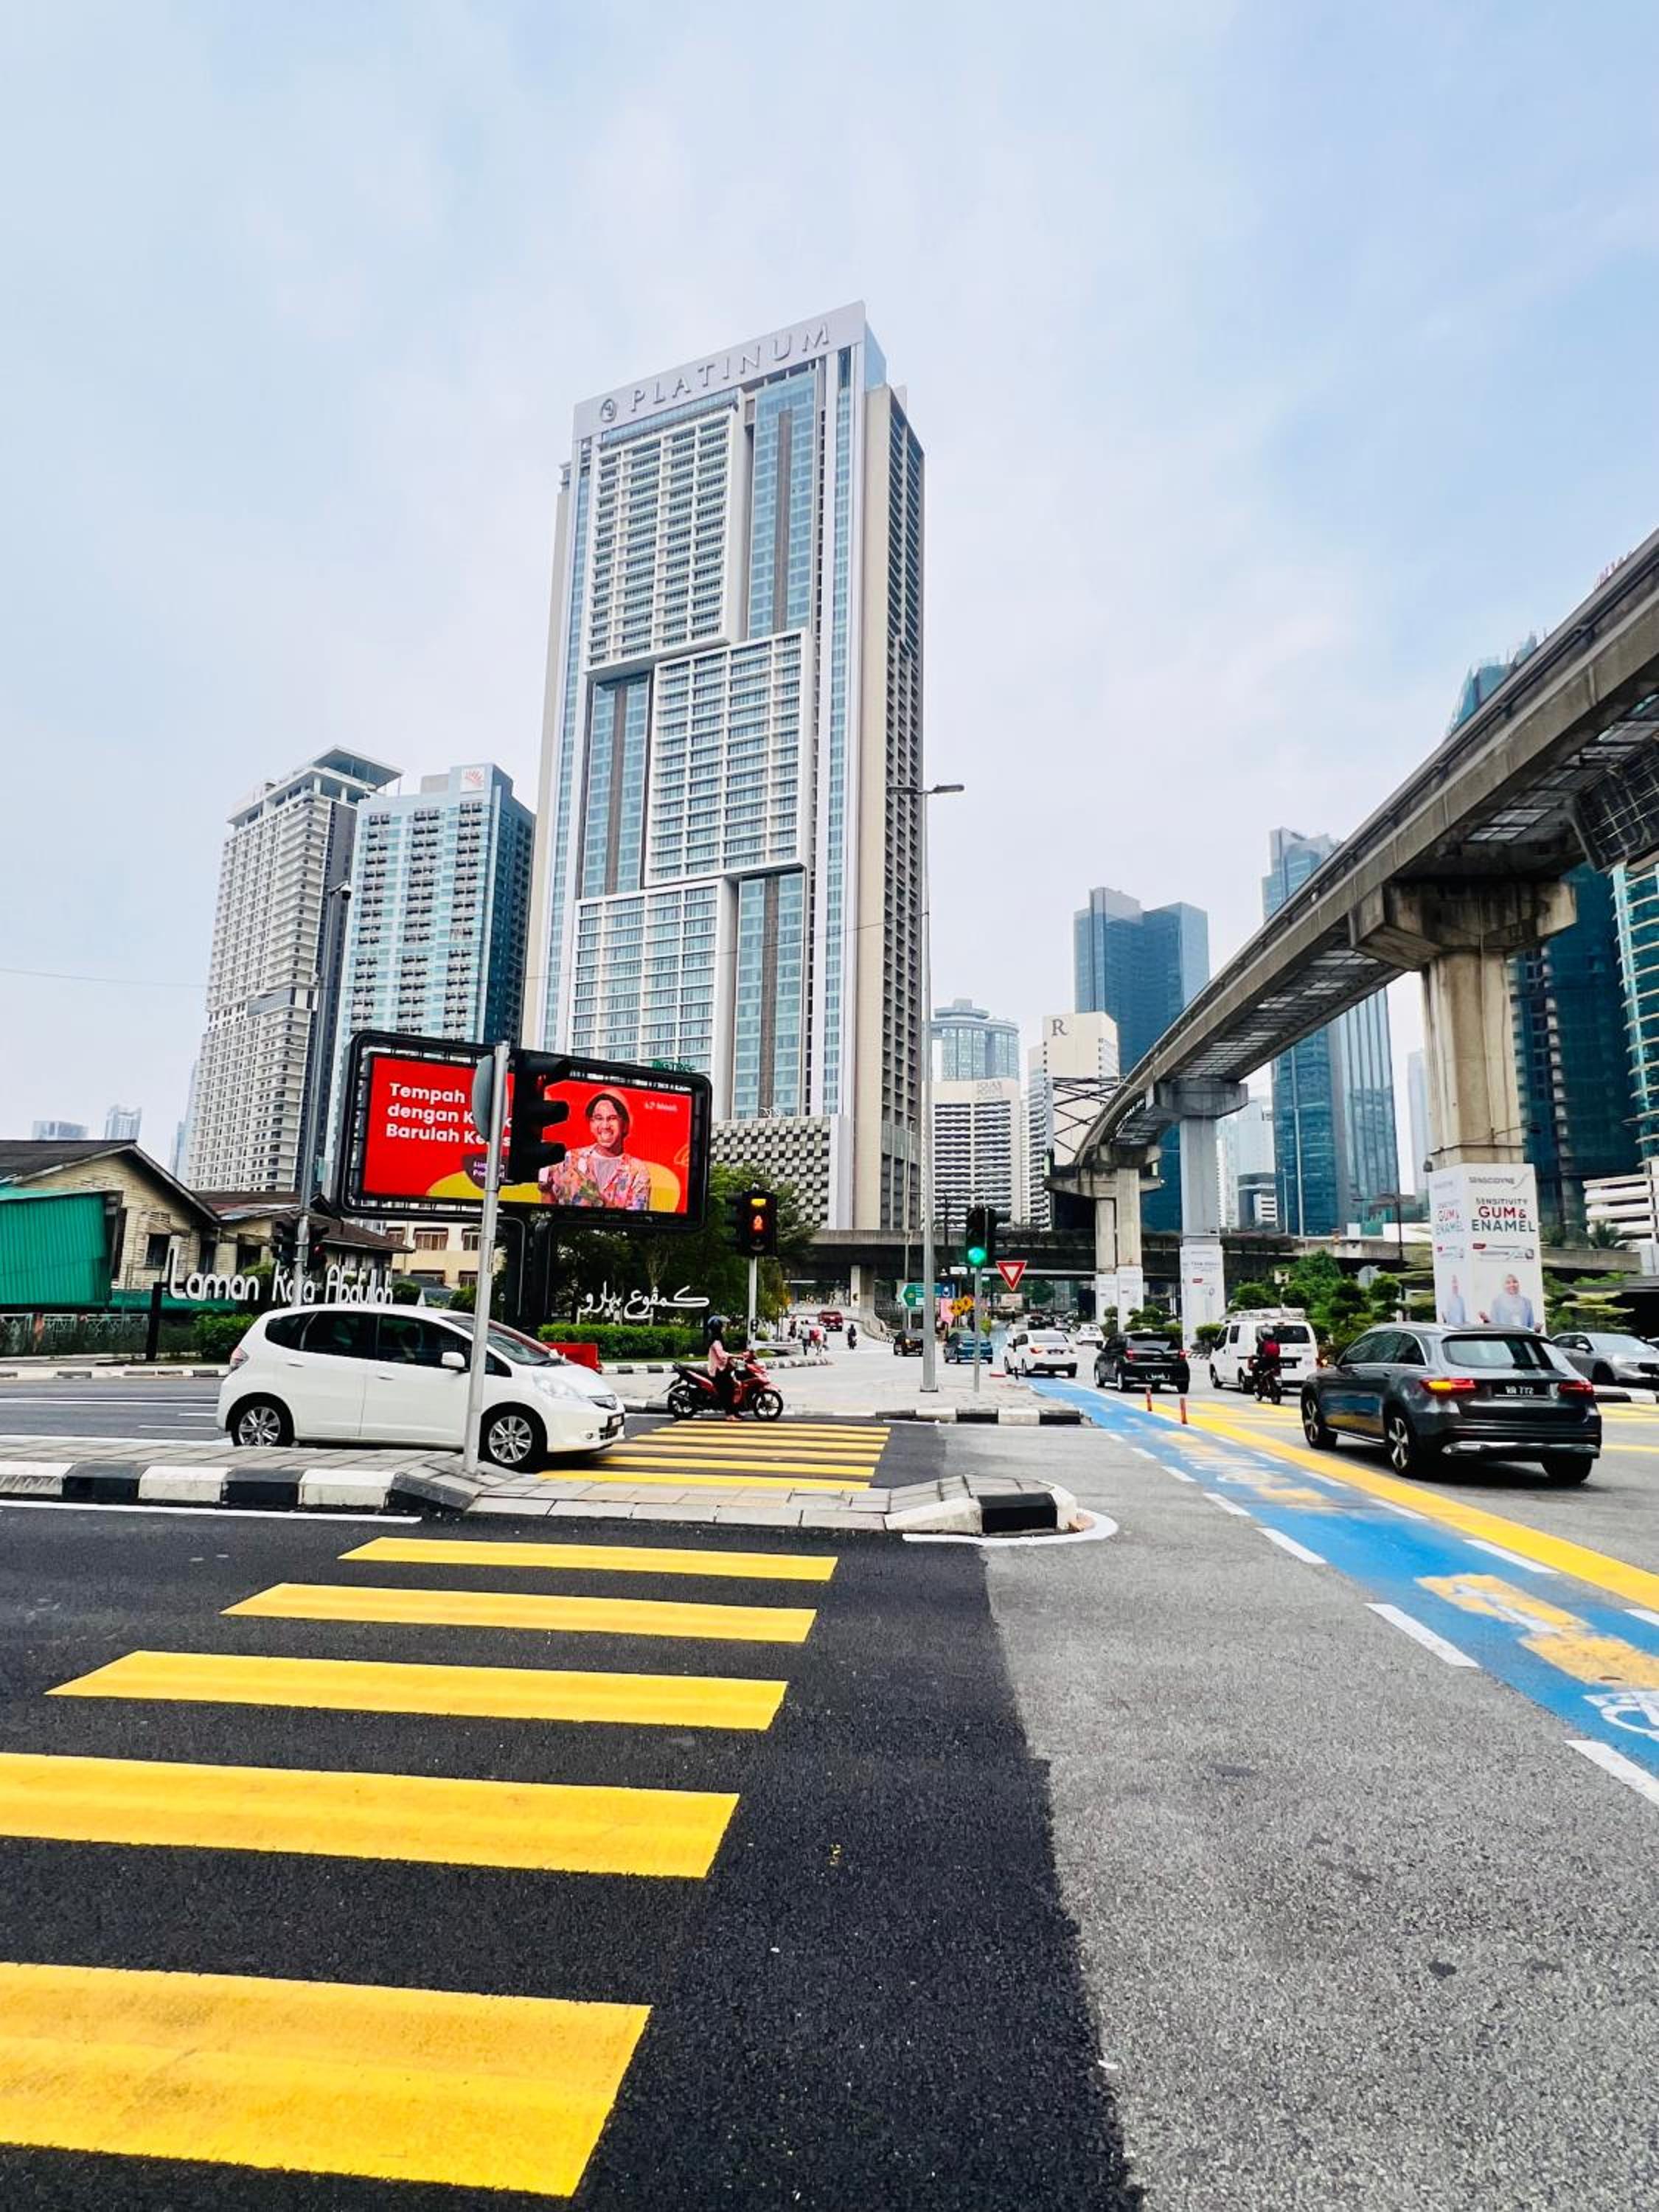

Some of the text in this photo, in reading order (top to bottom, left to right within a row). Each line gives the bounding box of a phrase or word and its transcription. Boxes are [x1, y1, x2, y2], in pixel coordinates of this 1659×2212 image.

[631, 323, 830, 412] PLATINUM
[1051, 1019, 1068, 1036] R
[389, 1082, 466, 1105] Tempah
[387, 1102, 459, 1124] dengan
[386, 1123, 512, 1147] Barulah Kes
[1475, 1197, 1528, 1206] SENSITIVITY
[1478, 1206, 1527, 1219] GUM &
[1471, 1219, 1537, 1233] ENAMEL
[170, 1246, 260, 1301] Laman
[324, 1263, 394, 1304] Abdullah
